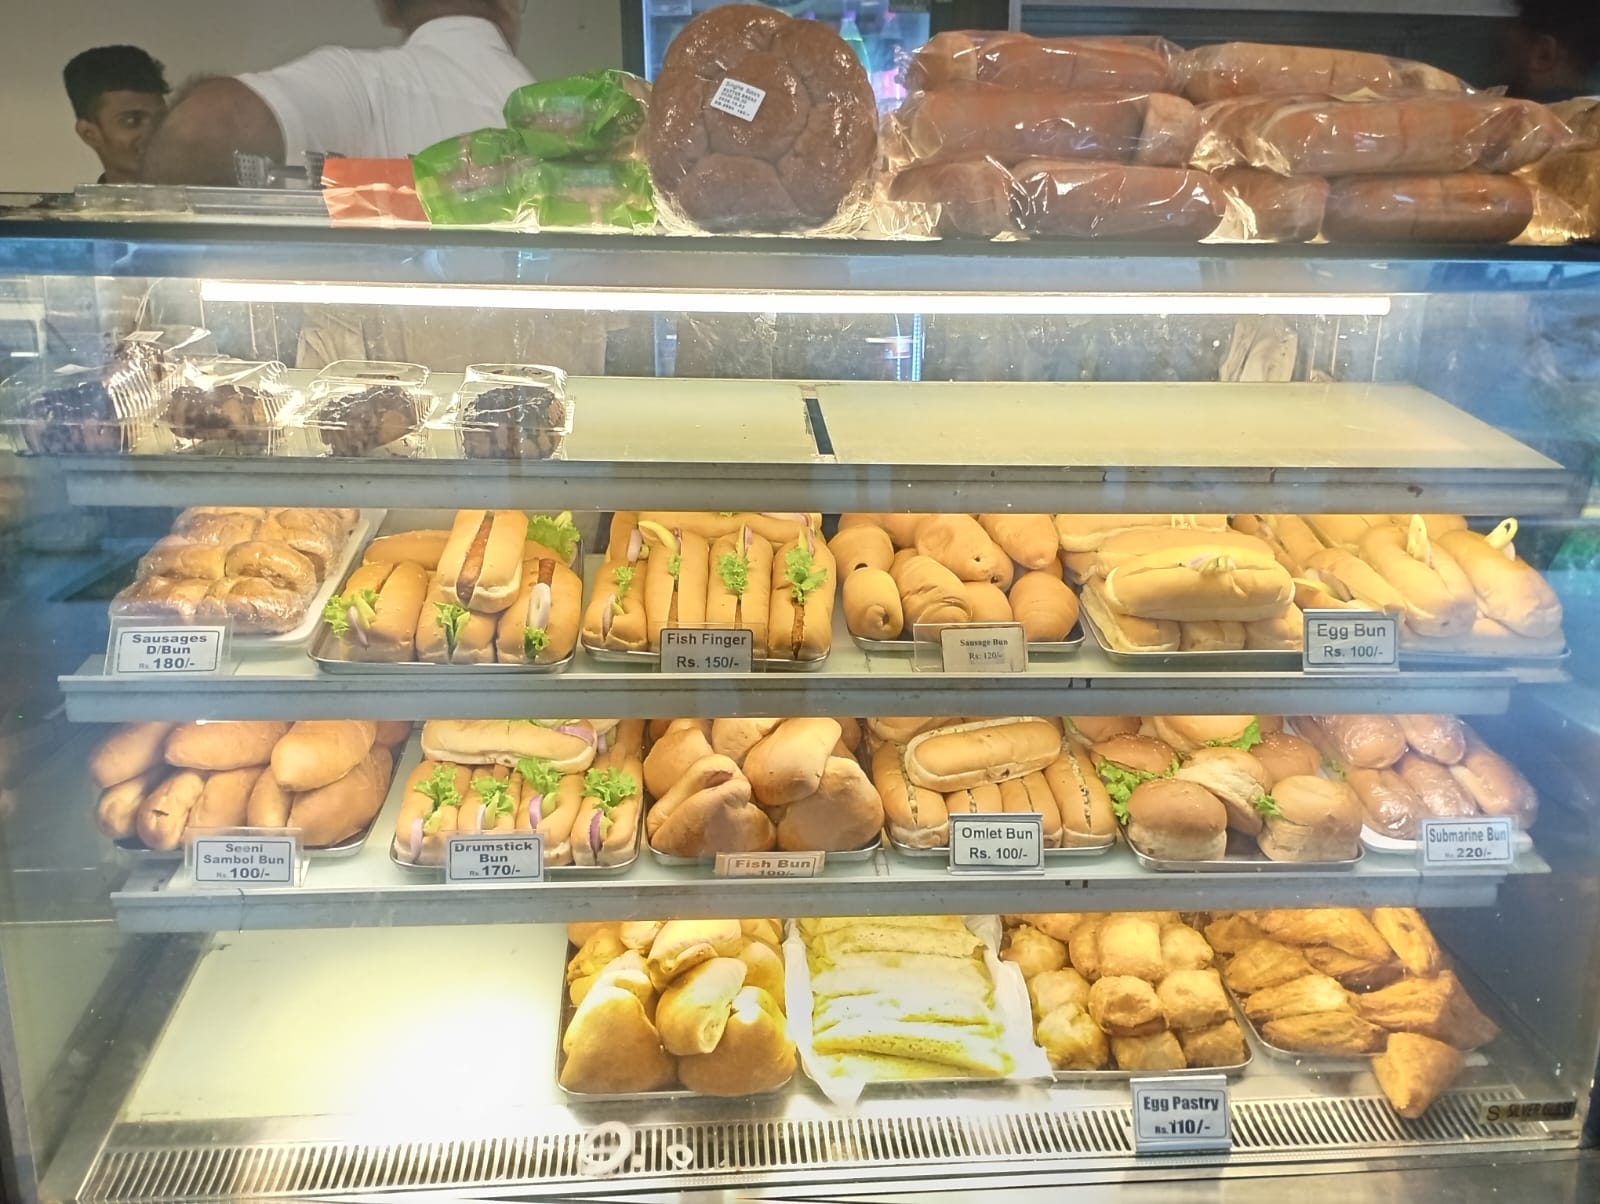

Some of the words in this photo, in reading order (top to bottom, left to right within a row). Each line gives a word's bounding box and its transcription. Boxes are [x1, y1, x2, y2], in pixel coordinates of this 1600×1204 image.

[1317, 624, 1348, 640] Egg
[1354, 624, 1386, 637] Bun
[132, 634, 207, 644] Sausages
[667, 633, 696, 645] Fish
[702, 634, 747, 648] Finger
[146, 645, 191, 654] D/Bun
[1324, 646, 1345, 657] Rs.
[1350, 646, 1383, 657] 100/-
[984, 651, 1003, 660] 120/-
[676, 656, 700, 668] Rs.
[704, 656, 739, 668] 150/-
[962, 827, 1002, 839] Omlet
[1006, 828, 1033, 839] Bun
[1429, 828, 1483, 842] Submarine
[1487, 827, 1506, 841] Bun
[225, 844, 263, 853] Seeni
[454, 842, 533, 852] Drumstick
[480, 854, 508, 862] Bun
[970, 847, 991, 859] Rs.
[996, 848, 1028, 859] 100/-
[203, 855, 253, 864] Sambol
[259, 855, 284, 864] Bun
[736, 860, 771, 868] Fish
[778, 859, 811, 868] Bun
[1143, 1097, 1169, 1112] Egg
[1172, 1096, 1219, 1111] Pastry
